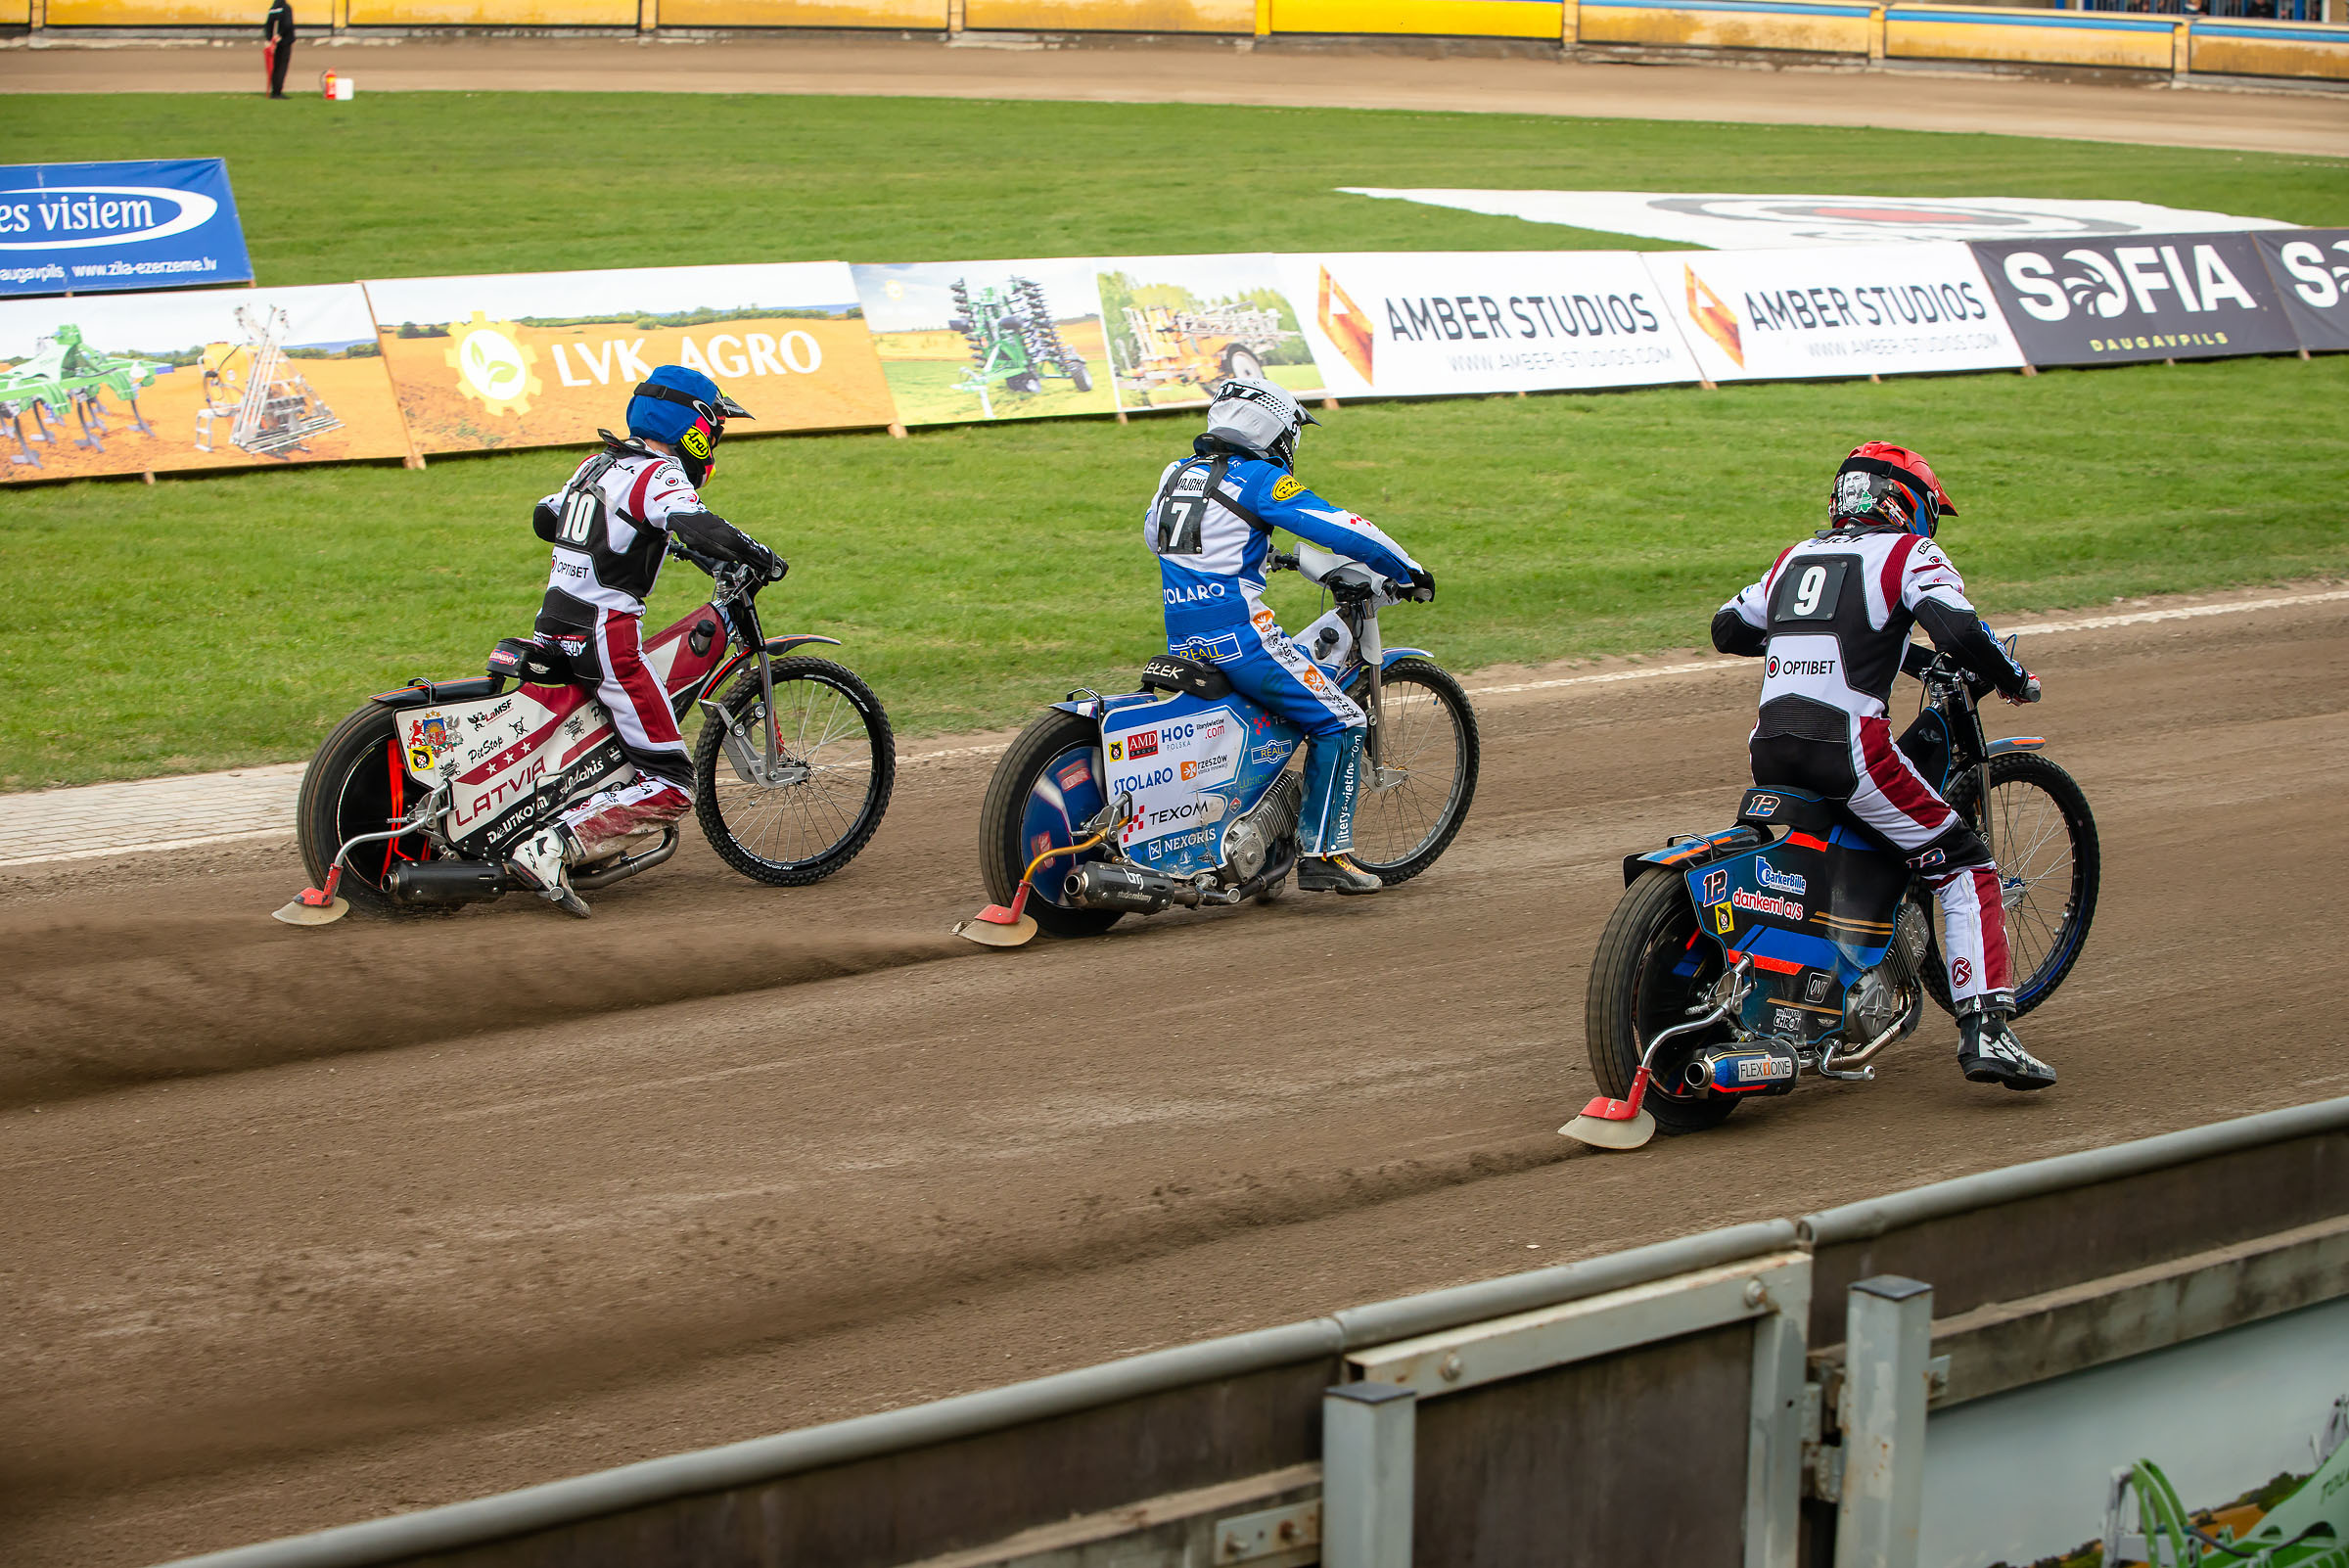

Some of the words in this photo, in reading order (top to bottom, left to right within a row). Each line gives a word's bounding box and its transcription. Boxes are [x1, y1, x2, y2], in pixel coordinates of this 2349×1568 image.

[37, 195, 156, 231] visiem
[2004, 244, 2257, 322] SOFIA
[1385, 296, 1511, 342] AMBER
[1508, 293, 1660, 340] STUDIOS
[1744, 287, 1861, 332] AMBER
[1856, 281, 1987, 326] STUDIOS
[2090, 331, 2230, 352] DAUGAVPILS
[551, 338, 652, 388] LVK
[680, 330, 823, 380] AGRO
[562, 490, 596, 542] 10
[1169, 501, 1193, 547] 7
[557, 561, 589, 578] OPTIBET
[1793, 566, 1827, 617] 9
[1782, 660, 1836, 675] OPTIBET
[484, 699, 513, 722] LaMSF
[1128, 732, 1157, 751] AMD
[1161, 723, 1194, 744] HOG
[1167, 740, 1191, 751] POLSKA
[468, 736, 504, 763] PitStop
[1260, 746, 1285, 759] REALL
[455, 756, 547, 827] LATVIA
[1114, 767, 1174, 796] STOLARO
[1149, 801, 1209, 825] TEXOM
[1745, 794, 1781, 817] 12
[1164, 828, 1217, 853] NEXORIS
[1703, 869, 1727, 907] 12
[1765, 869, 1807, 890] BarkerBille
[1732, 887, 1783, 916] dankemi
[1784, 900, 1804, 921] a/s
